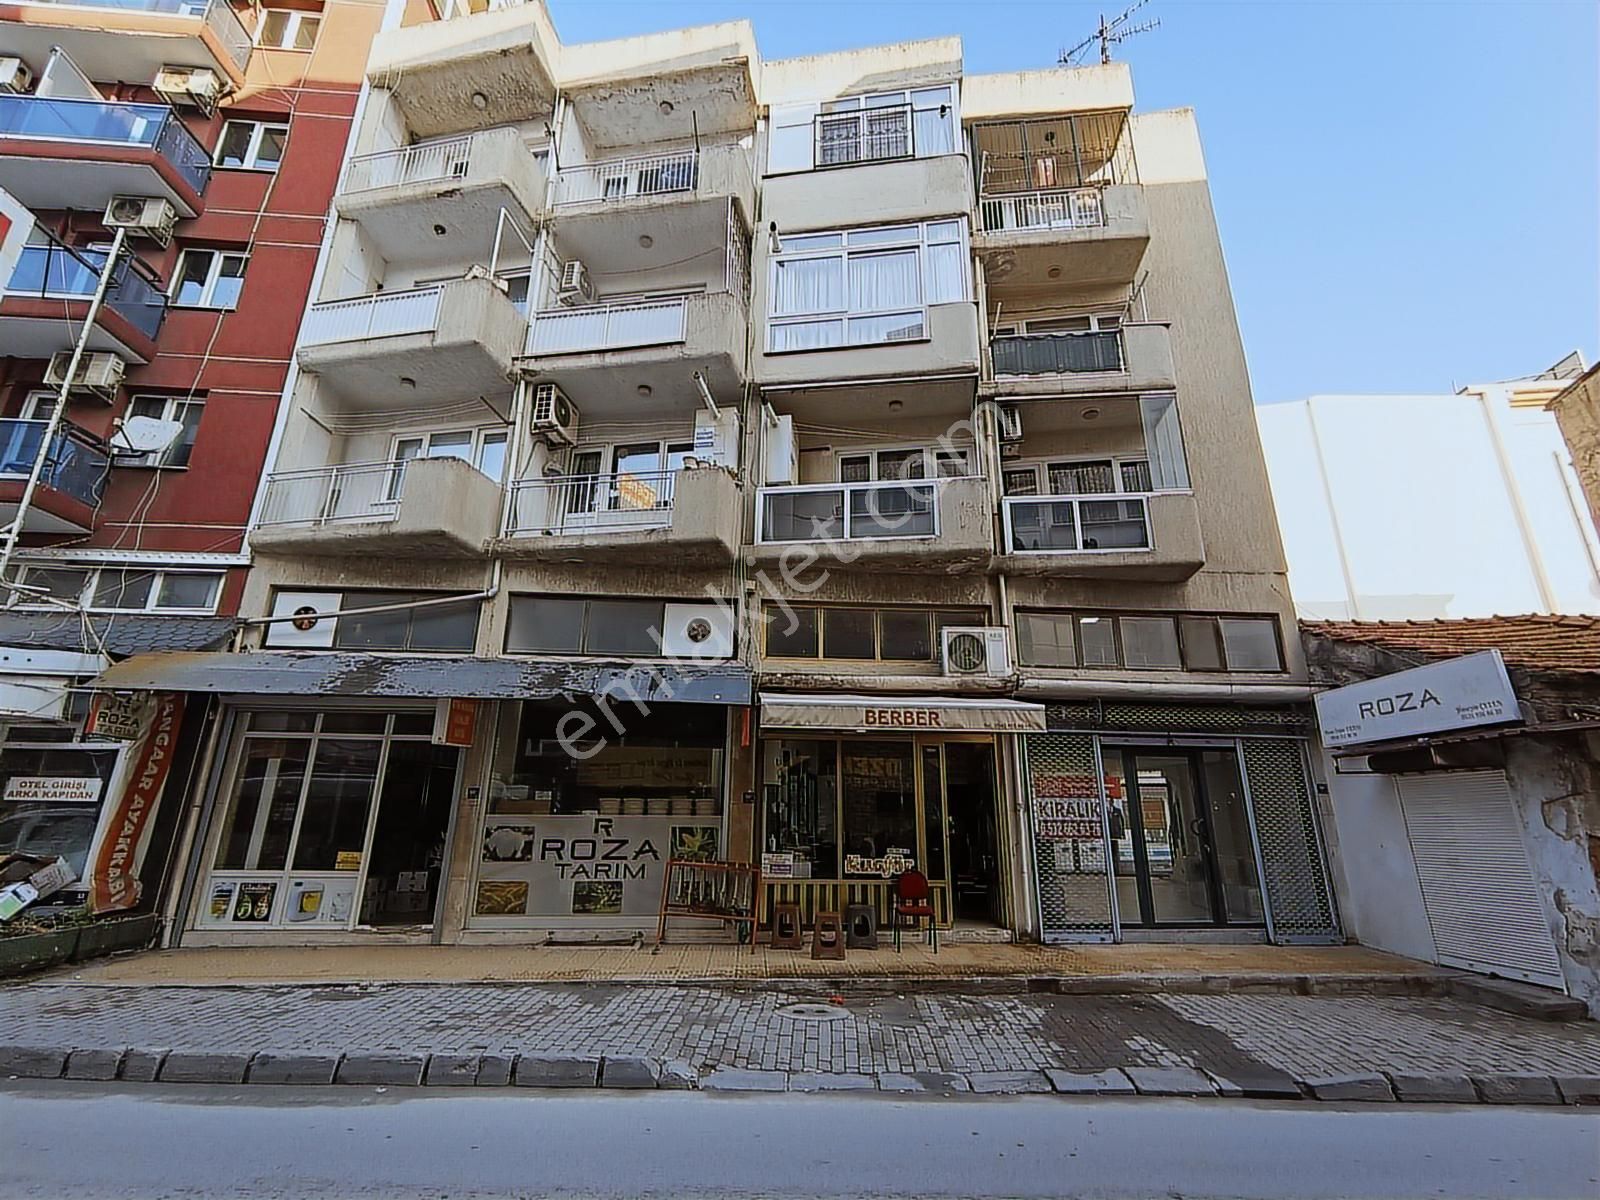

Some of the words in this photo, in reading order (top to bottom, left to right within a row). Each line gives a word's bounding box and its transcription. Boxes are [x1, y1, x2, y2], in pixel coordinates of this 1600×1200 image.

[1358, 688, 1441, 720] ROZA
[97, 711, 140, 728] ROZA
[864, 709, 942, 727] BERBER
[19, 780, 48, 789] OTEL
[7, 790, 38, 799] ARKA
[42, 790, 93, 799] KAPIDAN
[540, 839, 660, 860] ROZA
[554, 863, 647, 880] TARIM
